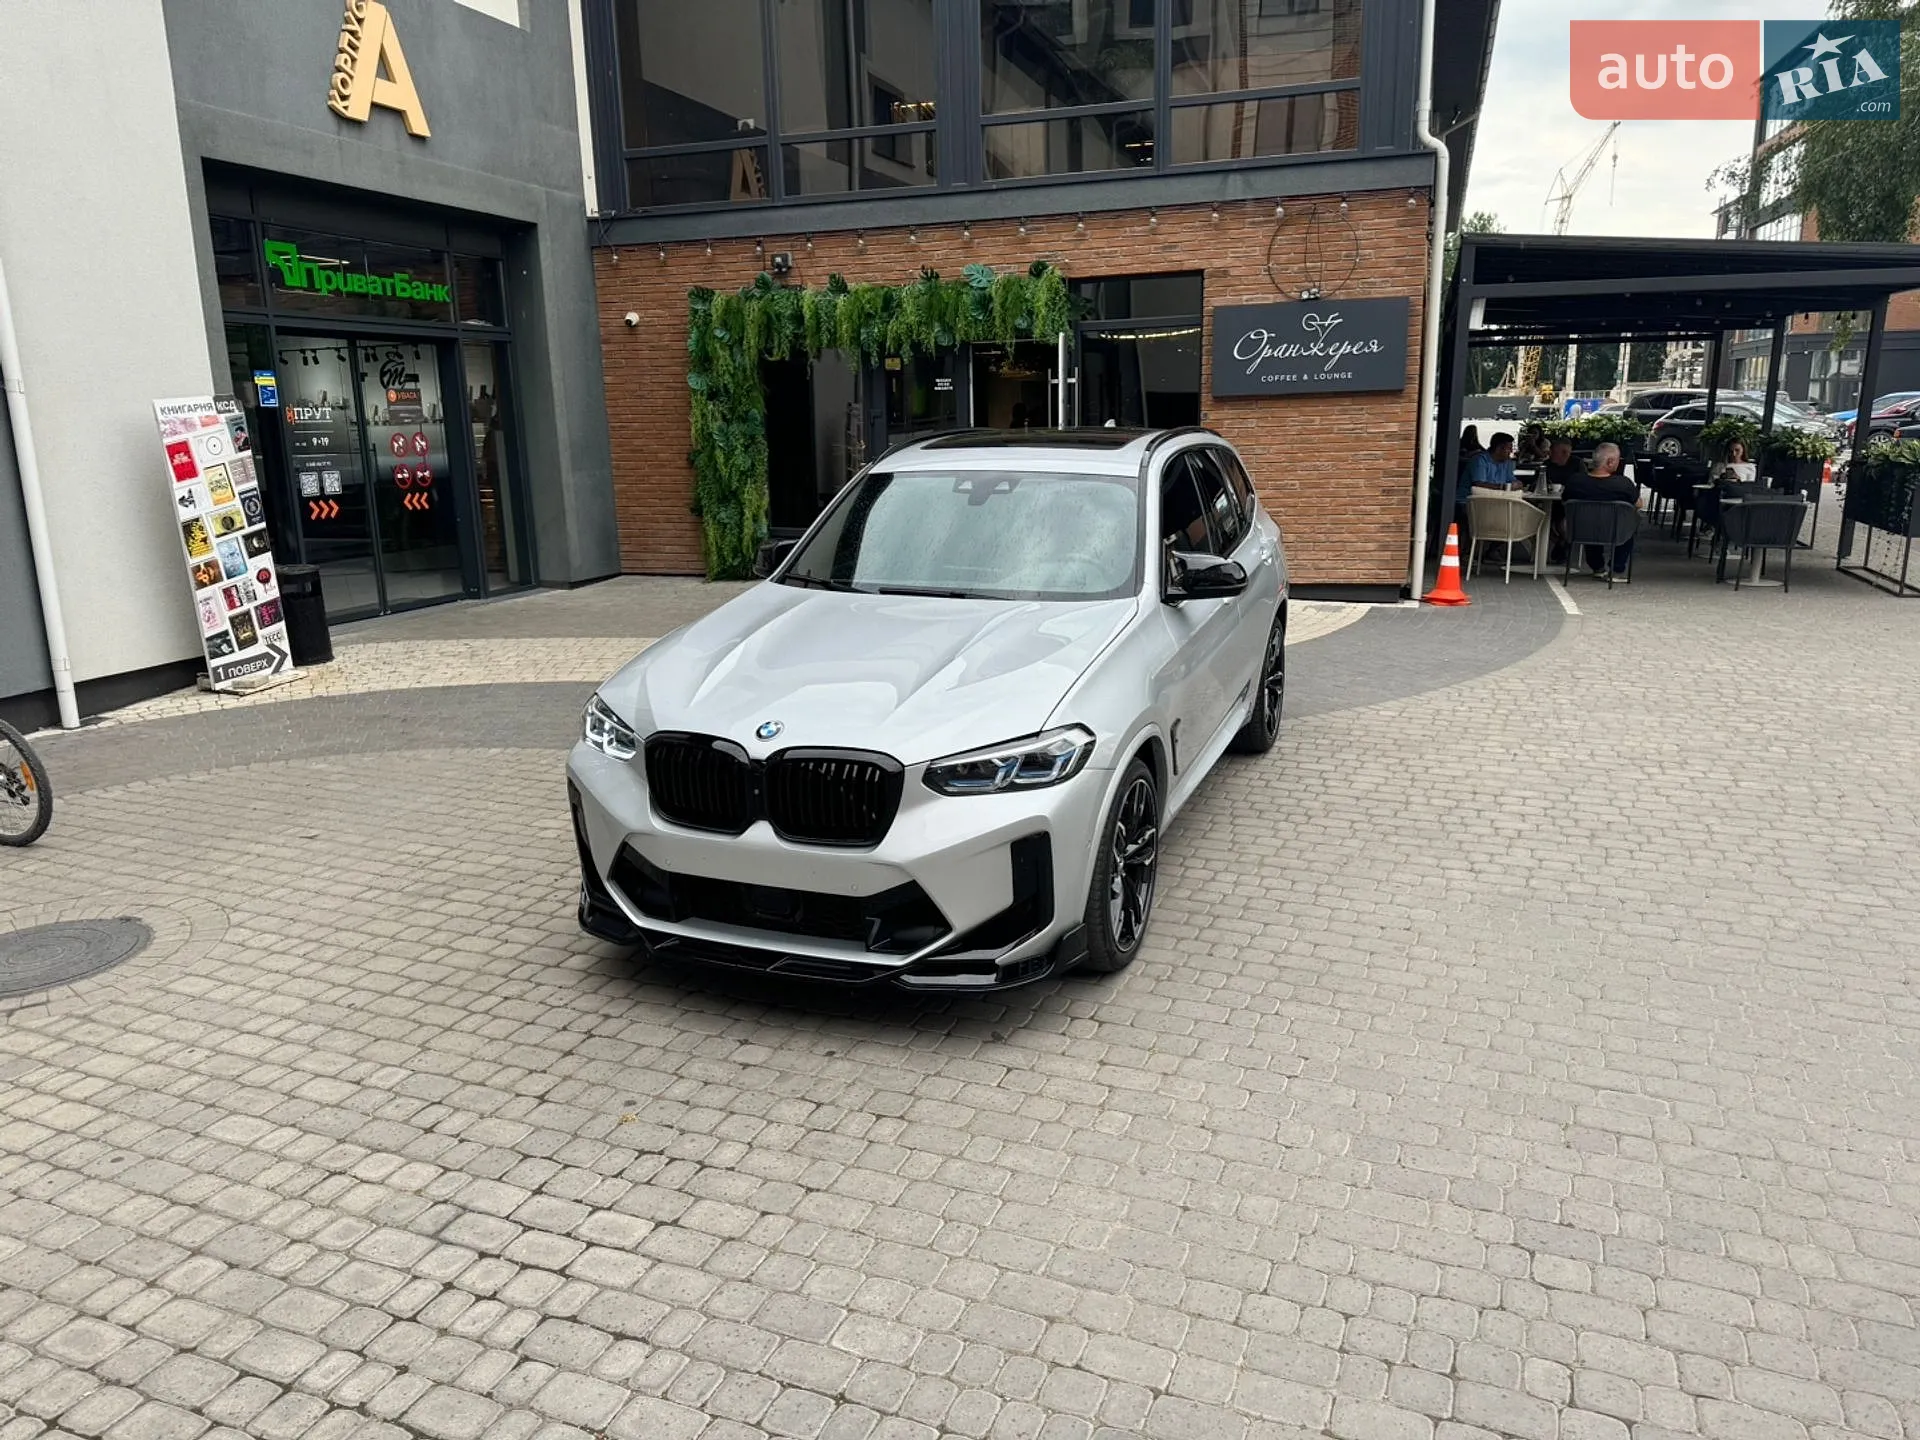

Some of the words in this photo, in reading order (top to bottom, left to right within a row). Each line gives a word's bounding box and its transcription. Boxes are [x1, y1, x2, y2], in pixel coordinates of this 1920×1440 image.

[301, 262, 451, 303] ПриватБанк
[1233, 327, 1384, 375] Оранжерея
[1261, 374, 1297, 383] COFFEE
[1314, 372, 1353, 381] LOUNGE
[160, 402, 214, 415] КНИГАРНЯ
[216, 400, 237, 412] КСД
[217, 666, 226, 680] 1
[227, 658, 269, 678] ПОВЕРХ
